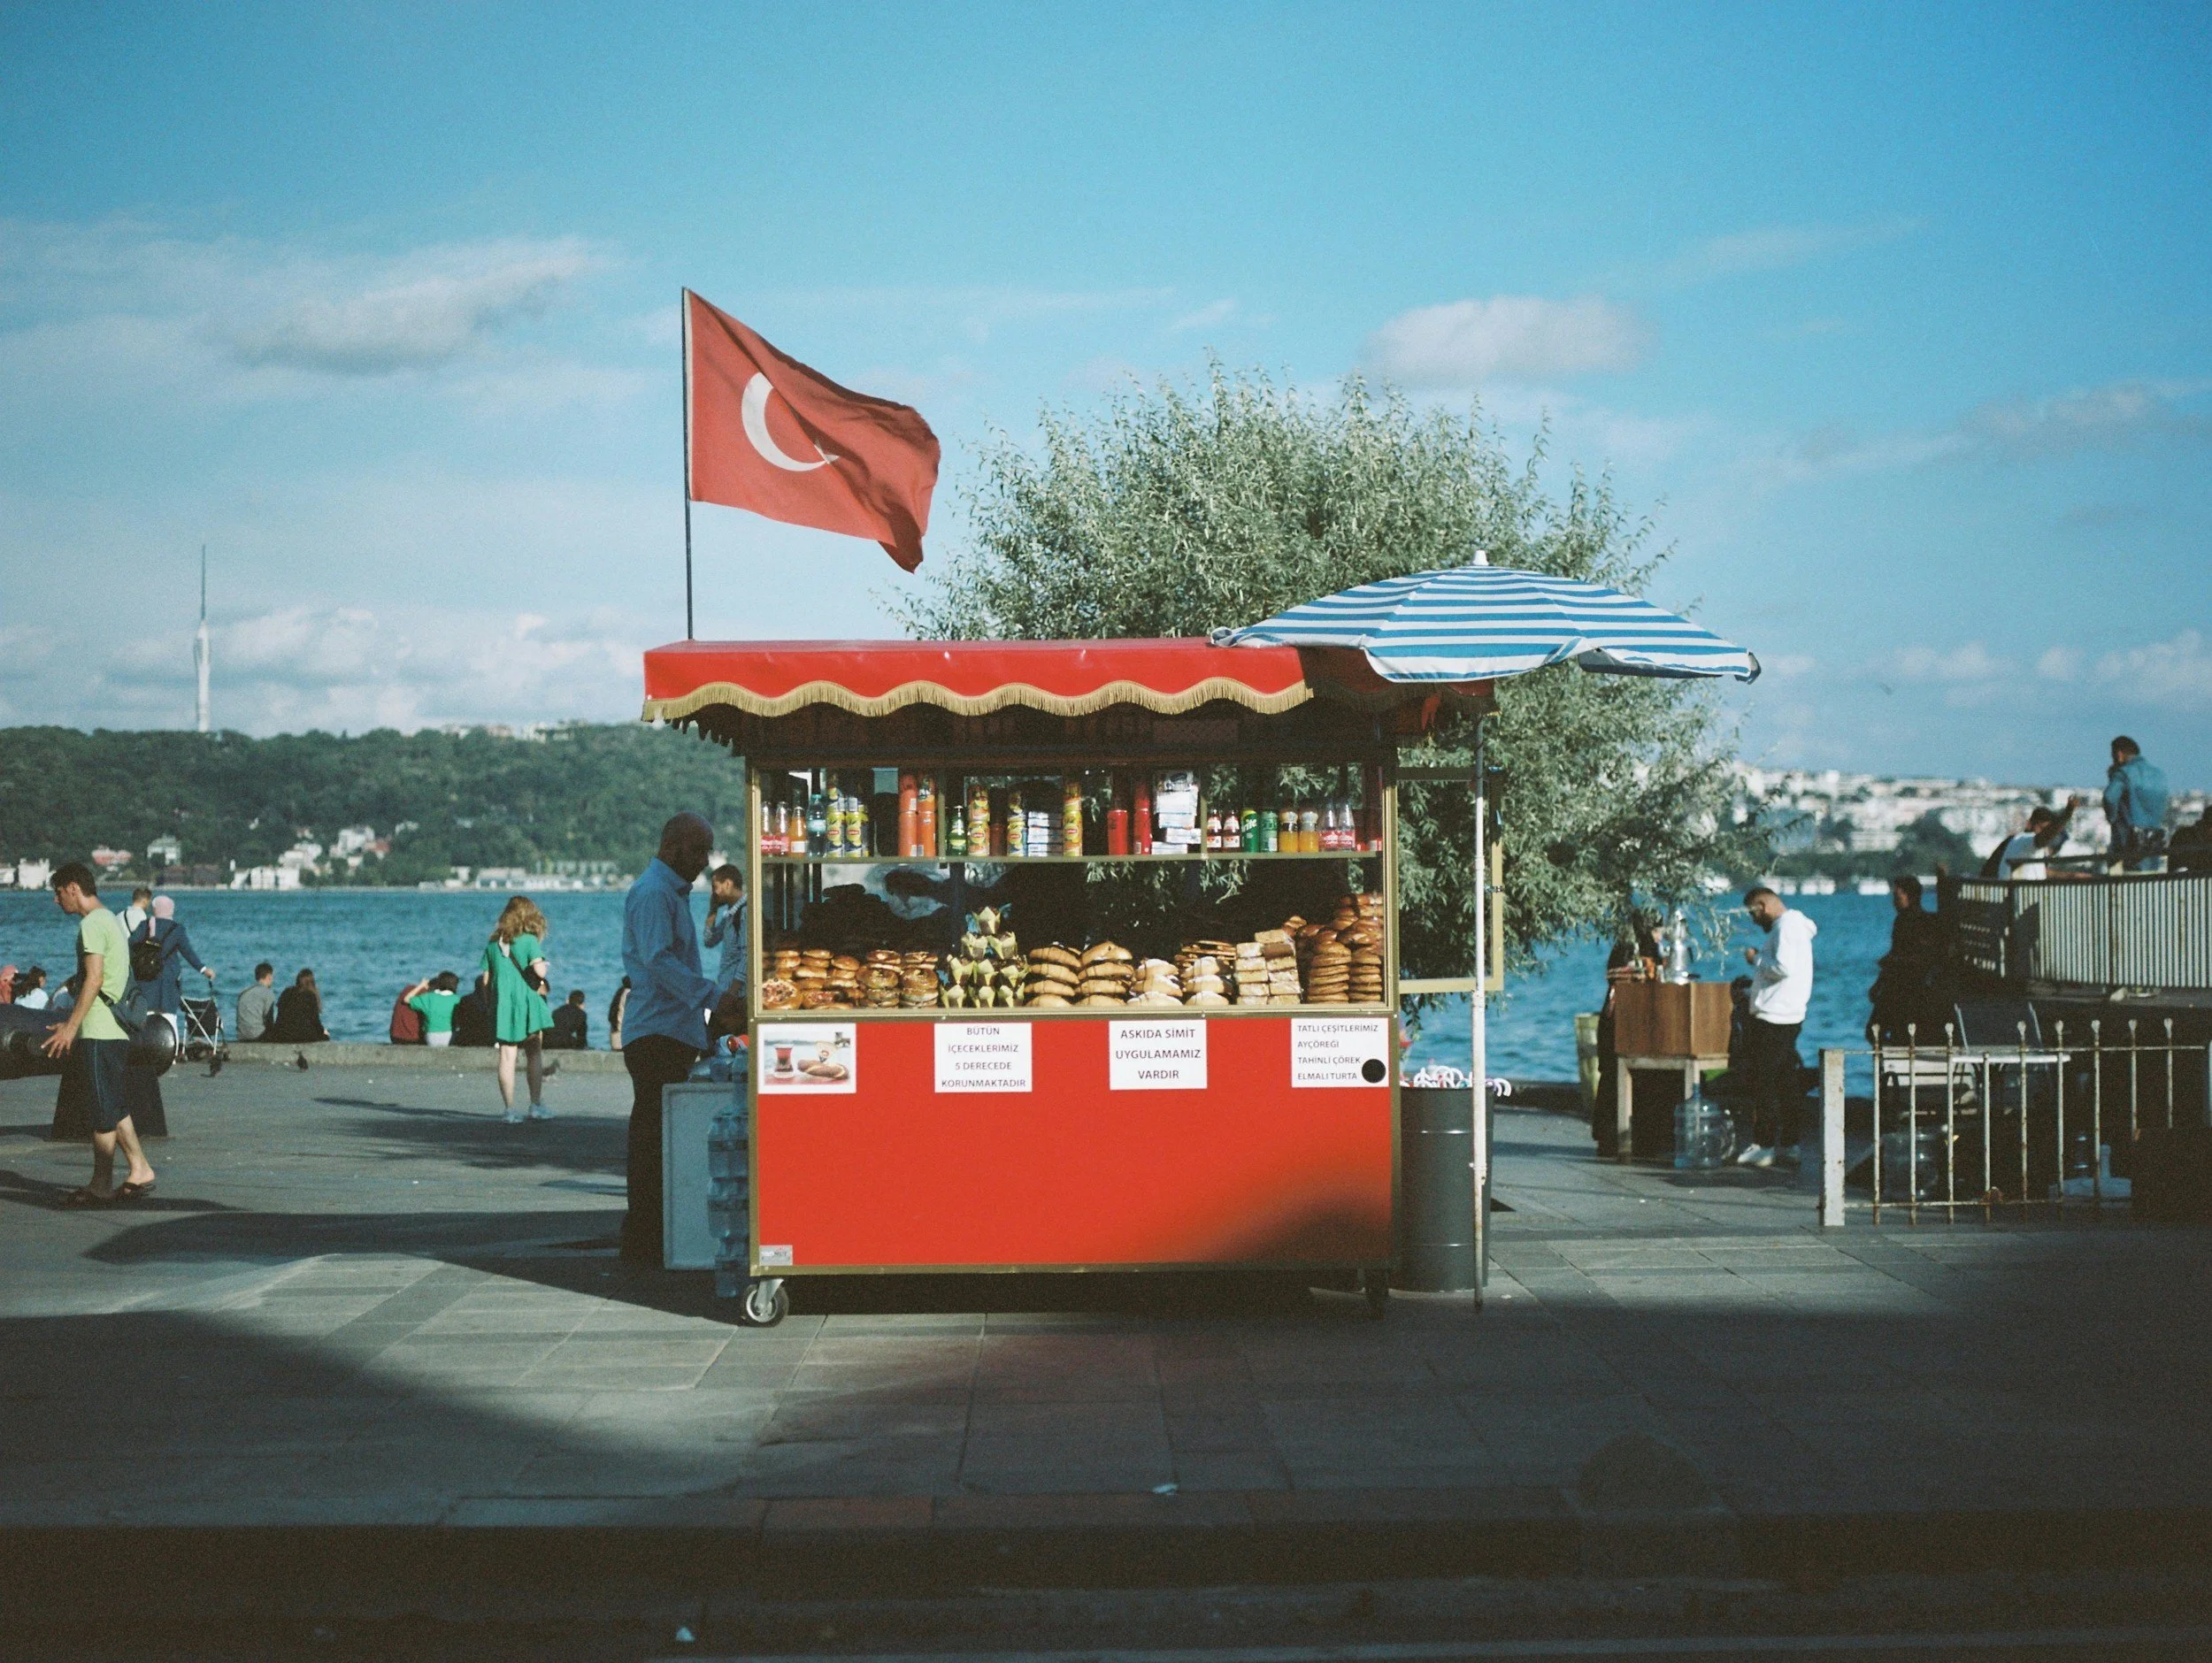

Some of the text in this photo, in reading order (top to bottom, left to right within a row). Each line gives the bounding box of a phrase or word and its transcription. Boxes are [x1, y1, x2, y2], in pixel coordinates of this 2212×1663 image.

[966, 1026, 1000, 1036] BÜTÜN
[1119, 1027, 1195, 1039] ASKIDA SİMİT
[1321, 1023, 1379, 1034] ÇEŞİTLERİMİZ
[1116, 1049, 1202, 1060] UYGULAMAMIZ
[963, 1061, 1011, 1070] DERECEDE
[1333, 1055, 1361, 1066] ÇÖREK
[1137, 1069, 1179, 1079] VARDIR
[941, 1079, 1026, 1088] KORUNMAKTADIR
